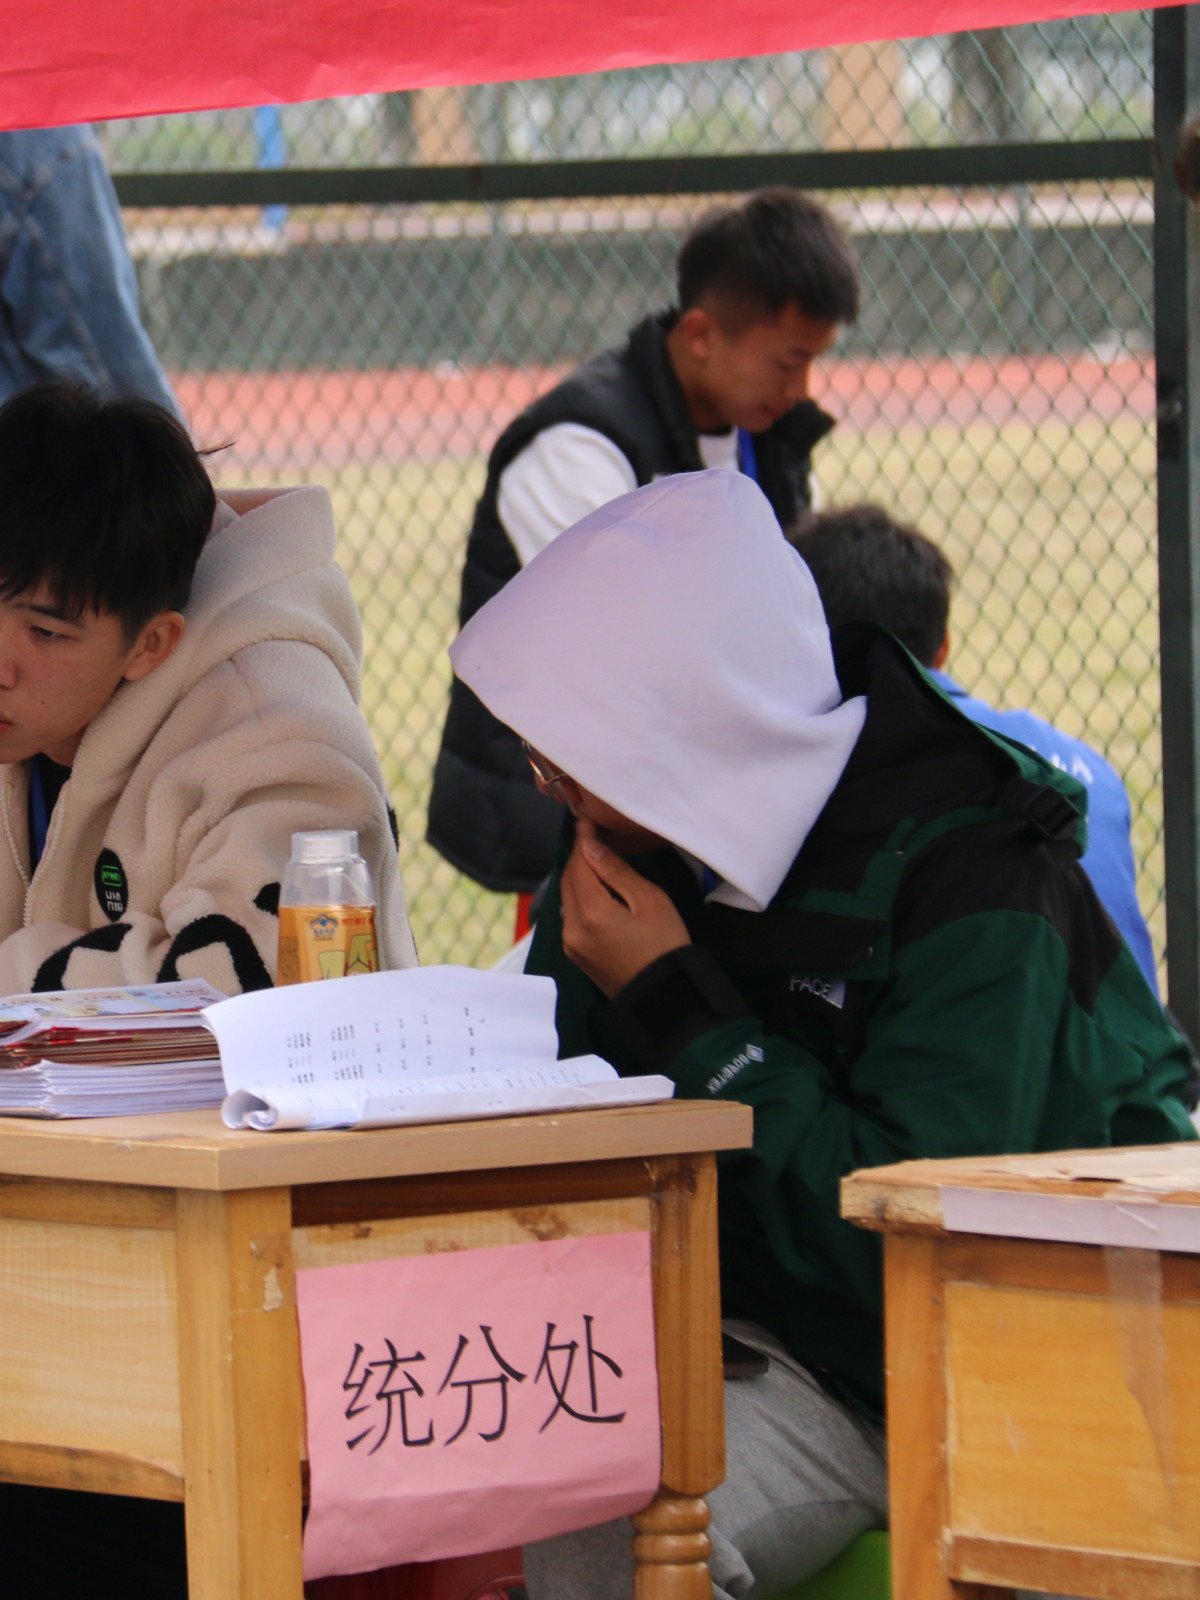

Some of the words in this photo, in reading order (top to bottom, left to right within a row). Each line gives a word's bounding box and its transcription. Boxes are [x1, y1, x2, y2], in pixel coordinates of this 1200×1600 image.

[789, 976, 832, 999] FACE
[342, 1314, 627, 1456] 统分处
